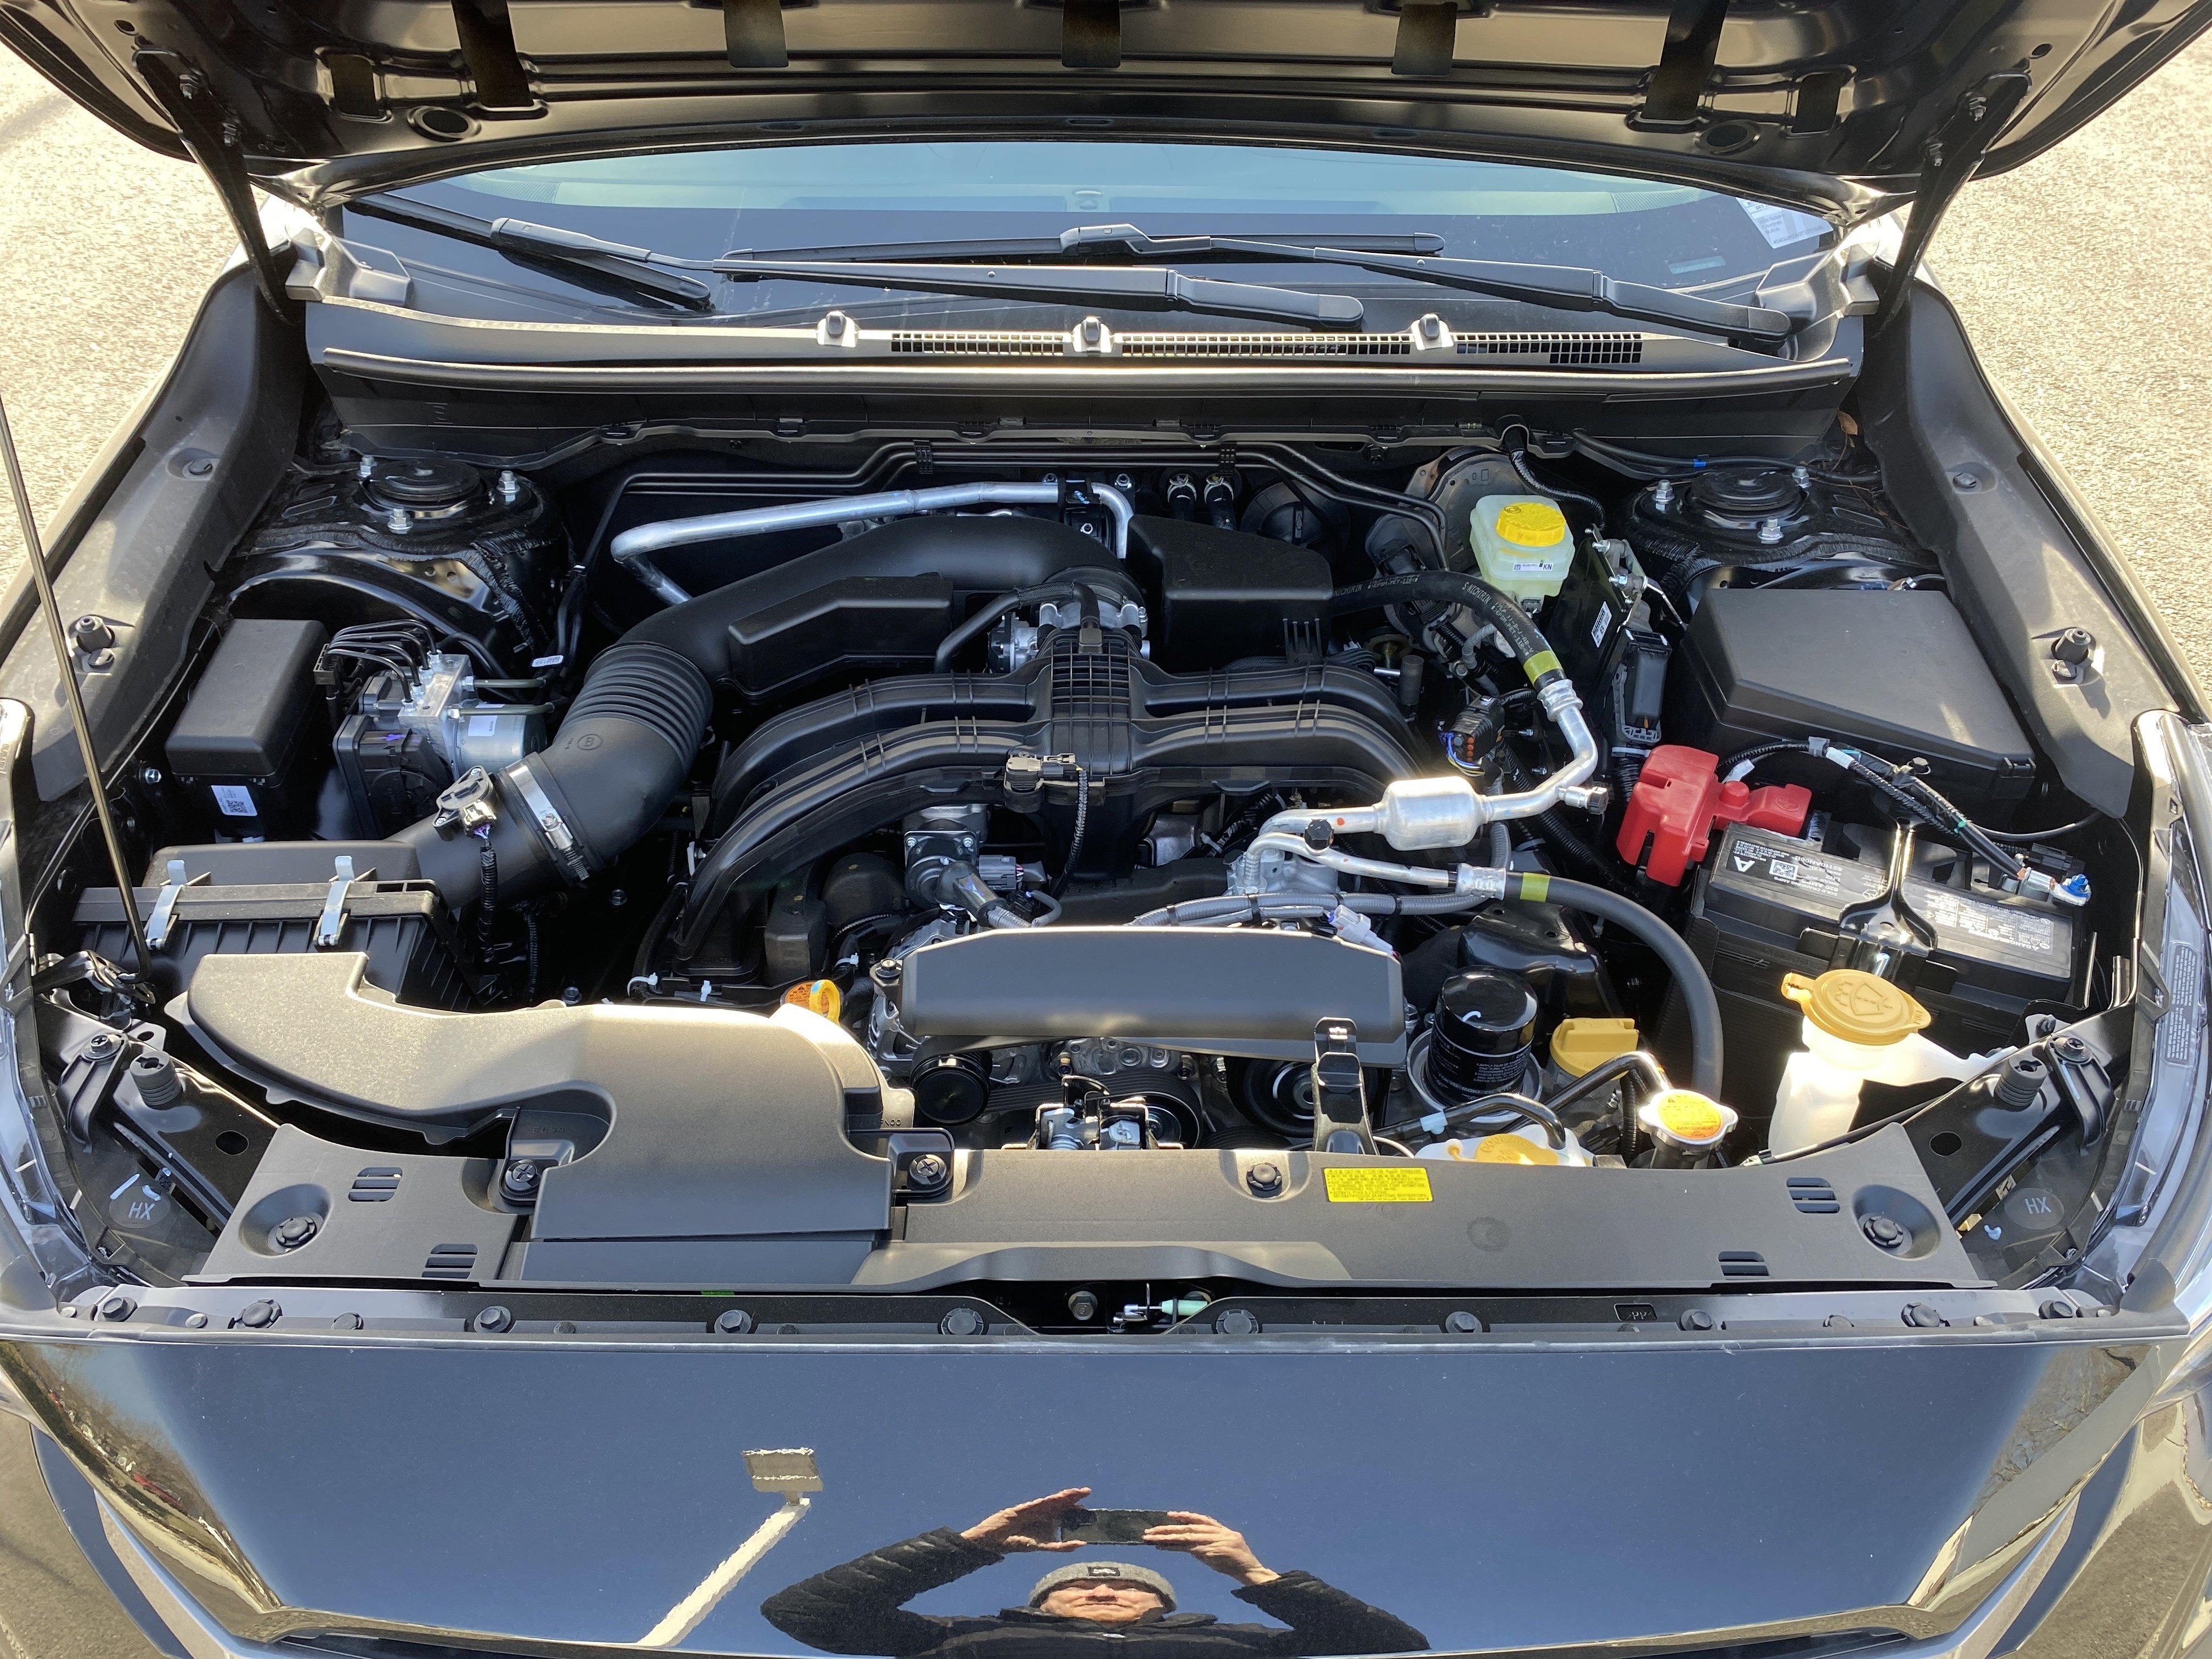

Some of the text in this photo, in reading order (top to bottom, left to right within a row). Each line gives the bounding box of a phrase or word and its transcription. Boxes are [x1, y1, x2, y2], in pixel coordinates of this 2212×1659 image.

[1733, 855, 1756, 872] A
[128, 1201, 156, 1221] HX
[2024, 1197, 2052, 1215] HX
